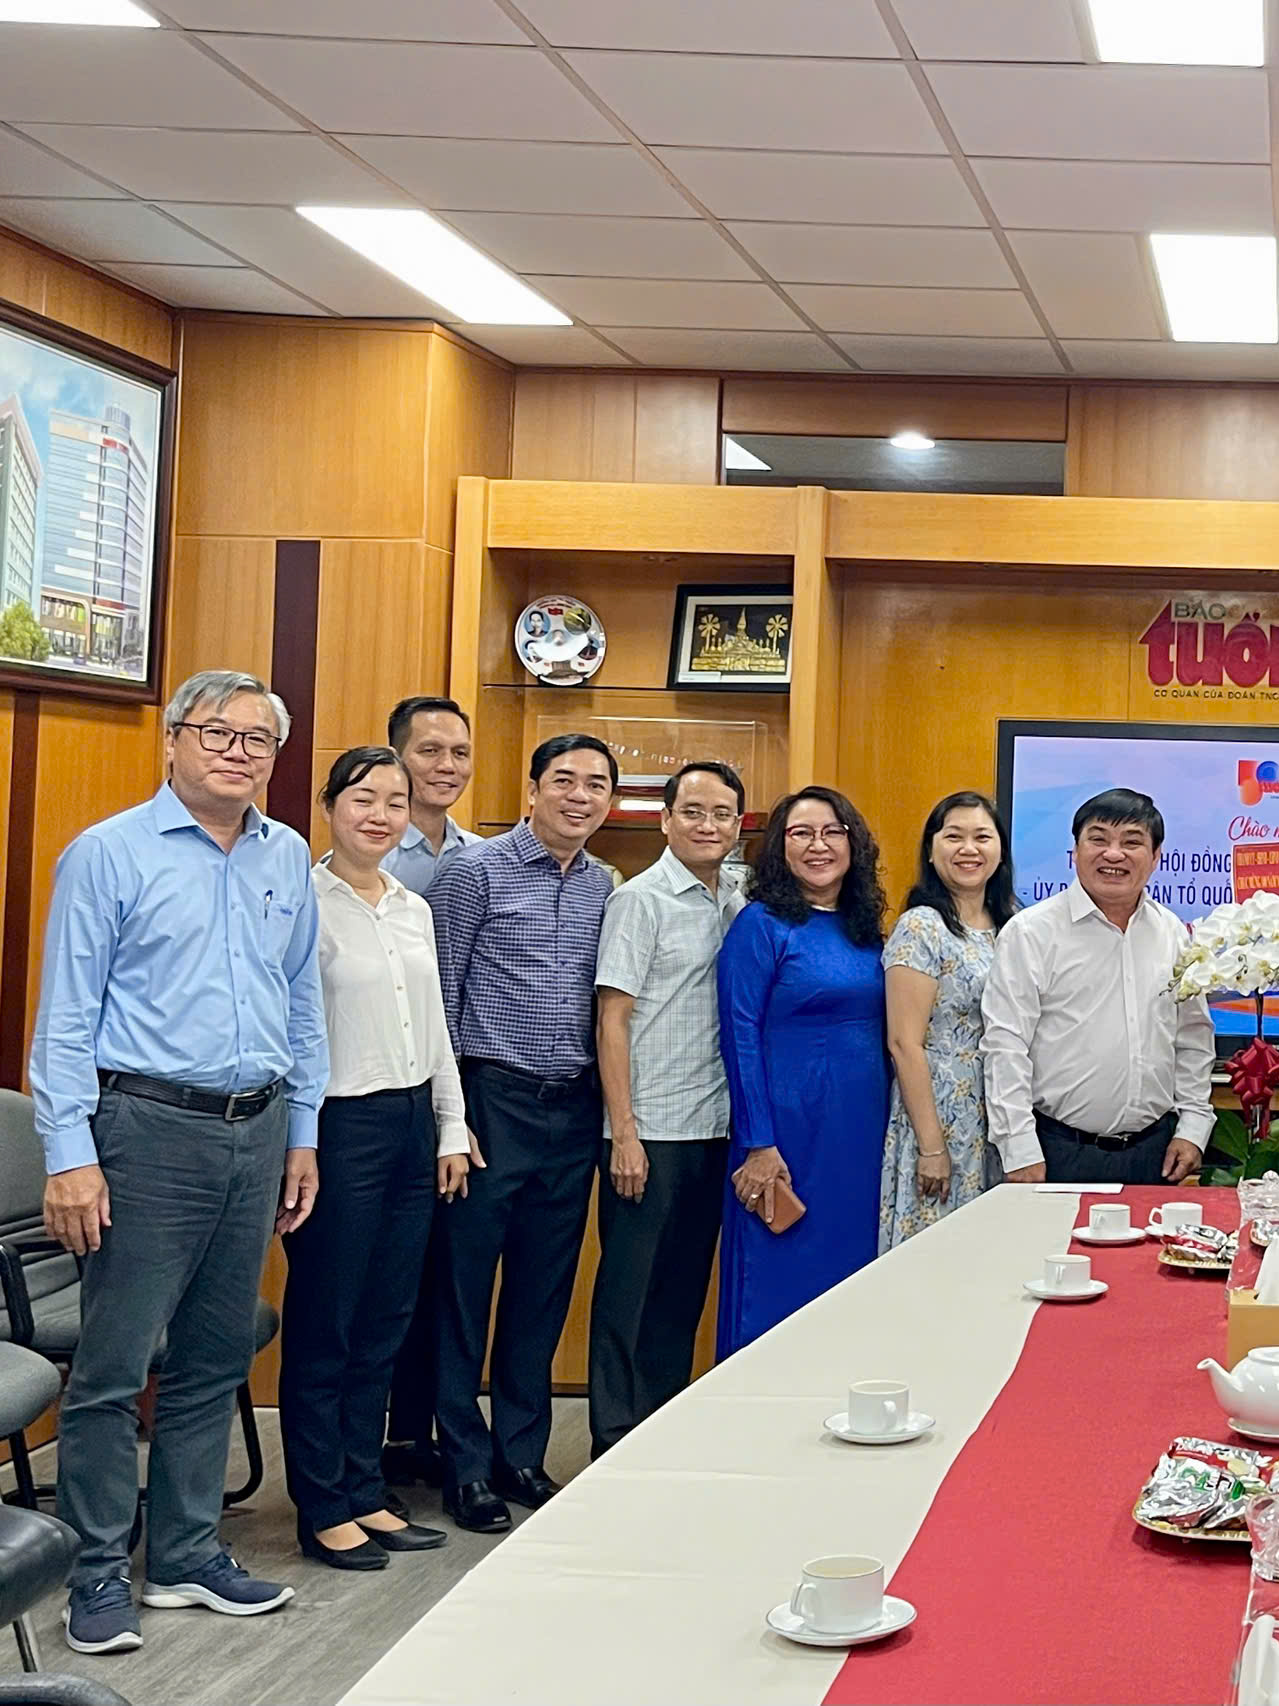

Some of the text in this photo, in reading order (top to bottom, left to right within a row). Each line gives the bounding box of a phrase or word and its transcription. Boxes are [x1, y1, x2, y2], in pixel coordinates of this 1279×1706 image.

[1174, 600, 1226, 620] BÁO
[1171, 690, 1200, 698] QUAN
[1228, 815, 1271, 841] Chào
[1160, 848, 1186, 877] HỘI
[1190, 845, 1232, 873] ĐỒNG
[1177, 877, 1196, 905] TỔ
